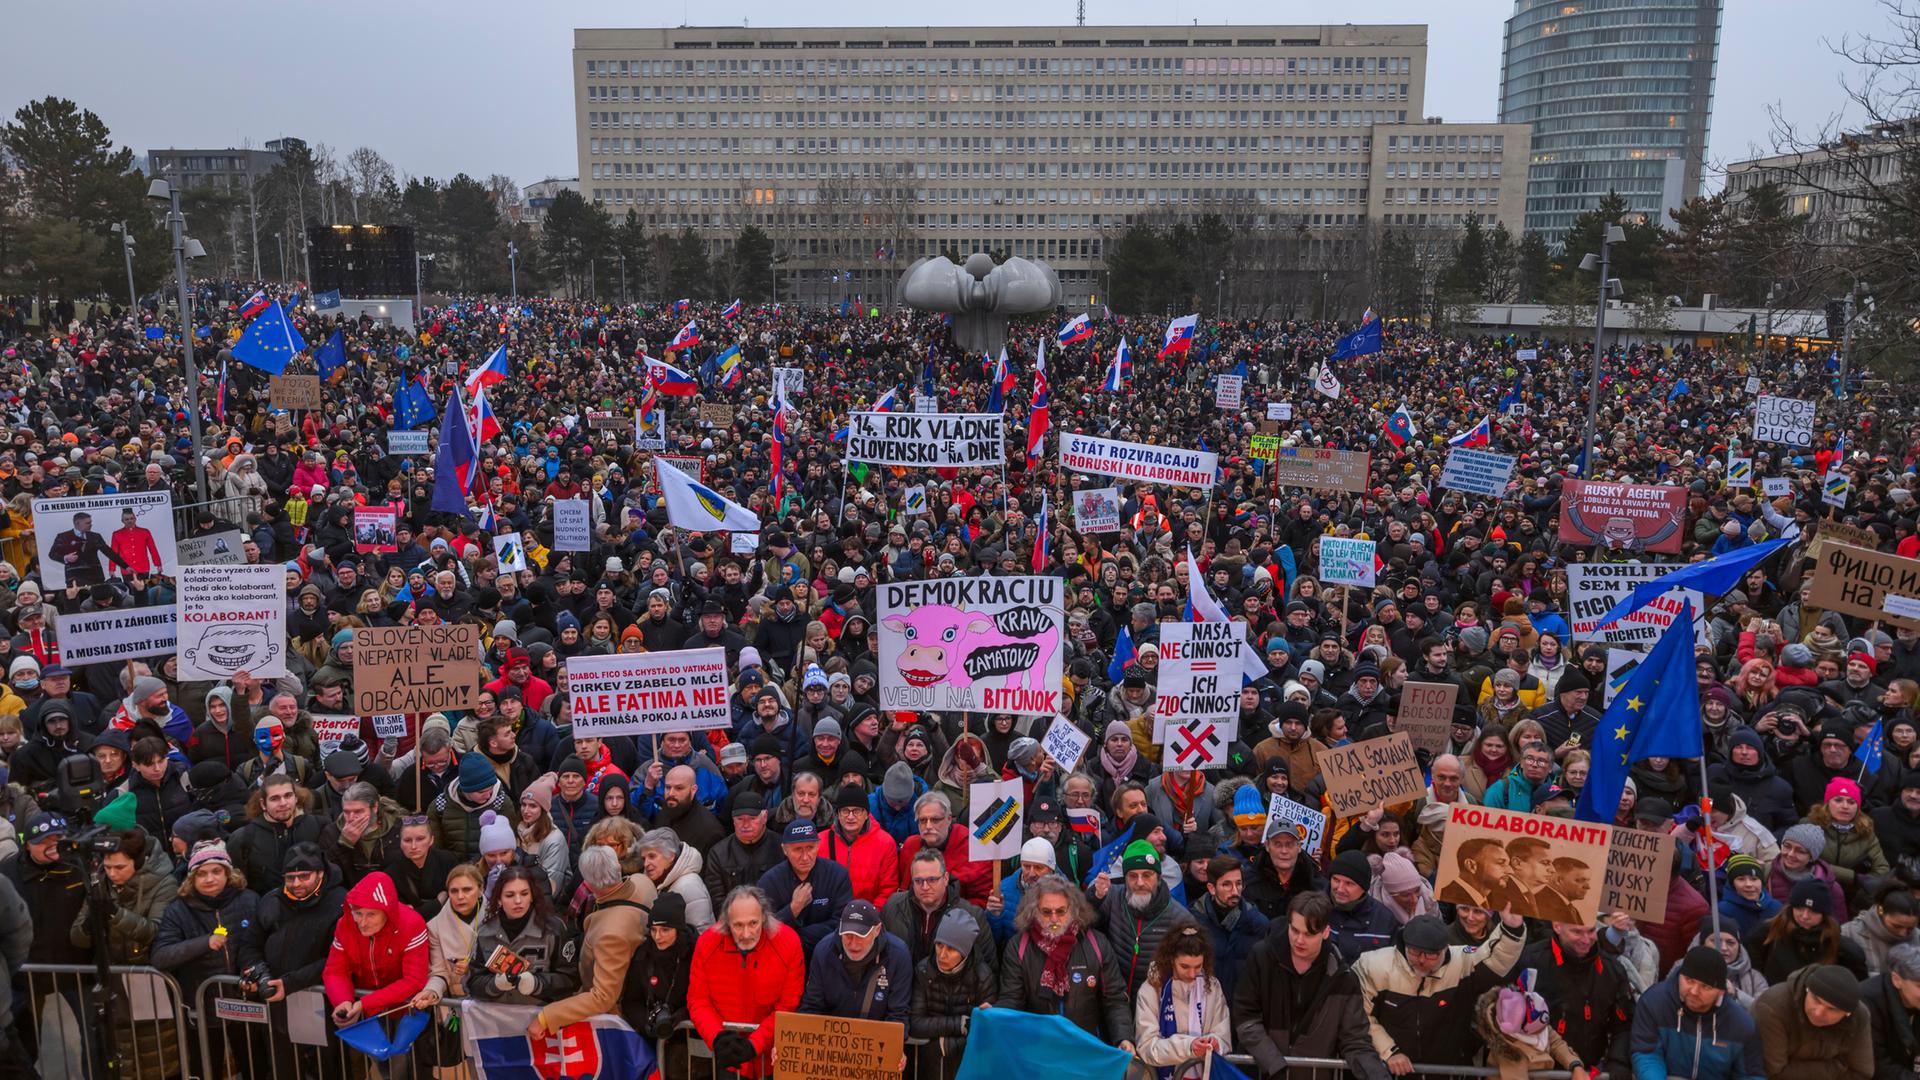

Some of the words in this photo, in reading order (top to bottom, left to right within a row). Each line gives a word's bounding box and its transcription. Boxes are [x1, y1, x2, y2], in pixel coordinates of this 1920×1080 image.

[854, 414, 878, 436] 14.
[886, 416, 922, 438] ROK
[928, 415, 1000, 440] VLÁDNE
[1757, 426, 1811, 446] PUCO
[850, 438, 938, 463] SLOVENSKO
[940, 441, 955, 453] JE
[948, 452, 964, 464] NA
[967, 441, 1000, 461] DNE
[1071, 438, 1105, 456] ŠTÁT
[1110, 446, 1199, 469] ROZVRACAJÚ
[1063, 453, 1123, 474] PRORUSKÍ
[1126, 463, 1211, 485] KOLABORANTI
[1584, 484, 1624, 497] RUSKÝ
[1626, 488, 1667, 500] AGENT
[1584, 496, 1610, 504] LOBUJE
[1622, 499, 1650, 508] KRVAVÝ
[51, 502, 86, 510] NEBUDEM
[88, 499, 113, 508] ŽIADNY
[1591, 506, 1624, 516] ADOLFA
[1626, 509, 1659, 519] PUTINA
[224, 567, 252, 575] vyzerá
[1583, 566, 1648, 576] MOHLI
[1830, 549, 1894, 589] ФИЦО,
[888, 579, 1054, 609] DEMOKRACIU
[1579, 581, 1620, 591] SEM
[184, 611, 270, 623] KOLABORANT
[1573, 595, 1616, 619] FICO
[70, 624, 82, 634] AJ
[85, 620, 112, 632] KÚTY
[115, 620, 123, 628] A
[125, 614, 168, 627] ZÁHORIE
[997, 611, 1050, 633] KRAVU
[1192, 623, 1231, 640] NAŠA
[358, 628, 469, 647] SLOVENSKO
[1605, 627, 1657, 642] RICHTER
[66, 650, 74, 659] A
[76, 646, 112, 658] MUSIA
[114, 639, 153, 653] ZOSTAŤ
[358, 648, 419, 666] NEPATRÍ
[1160, 639, 1242, 659] NEČINNOSŤ
[965, 646, 1038, 676] ZAMATOVÚ
[390, 665, 444, 687] ALE
[570, 672, 600, 681] DIABOL
[602, 670, 620, 678] FICO
[669, 666, 680, 674] DO
[571, 682, 621, 693] CIRKEV
[626, 677, 686, 689] ZBABELO
[691, 673, 723, 685] MLČÍ
[1192, 675, 1218, 694] ICH
[361, 685, 471, 713] OBČANOM!
[574, 695, 610, 714] ALE
[617, 689, 688, 711] FATIMA
[693, 686, 726, 706] NIE
[946, 687, 975, 709] NA
[984, 685, 1058, 714] BITÚNOK
[1157, 691, 1240, 716] ZLOČINNOSŤ
[1411, 688, 1447, 705] FICO
[386, 715, 403, 724] SME
[574, 716, 589, 727] TÁ
[592, 713, 639, 726] PRINÁŠA
[642, 710, 677, 723] POKOJ
[681, 711, 688, 719] A
[691, 708, 726, 719] LÁSKU
[1324, 750, 1365, 777] VRAJ
[1272, 805, 1282, 814] JE
[1274, 796, 1323, 822] SLOVENSKO
[1452, 807, 1607, 846] KOLABORANTI
[1612, 830, 1660, 852] ECHCEME
[1608, 891, 1647, 913] PLYN
[780, 1030, 797, 1043] MY
[827, 1035, 848, 1048] KTO
[851, 1038, 874, 1051] STE
[781, 1046, 800, 1060] STE
[780, 1059, 798, 1073] STE
